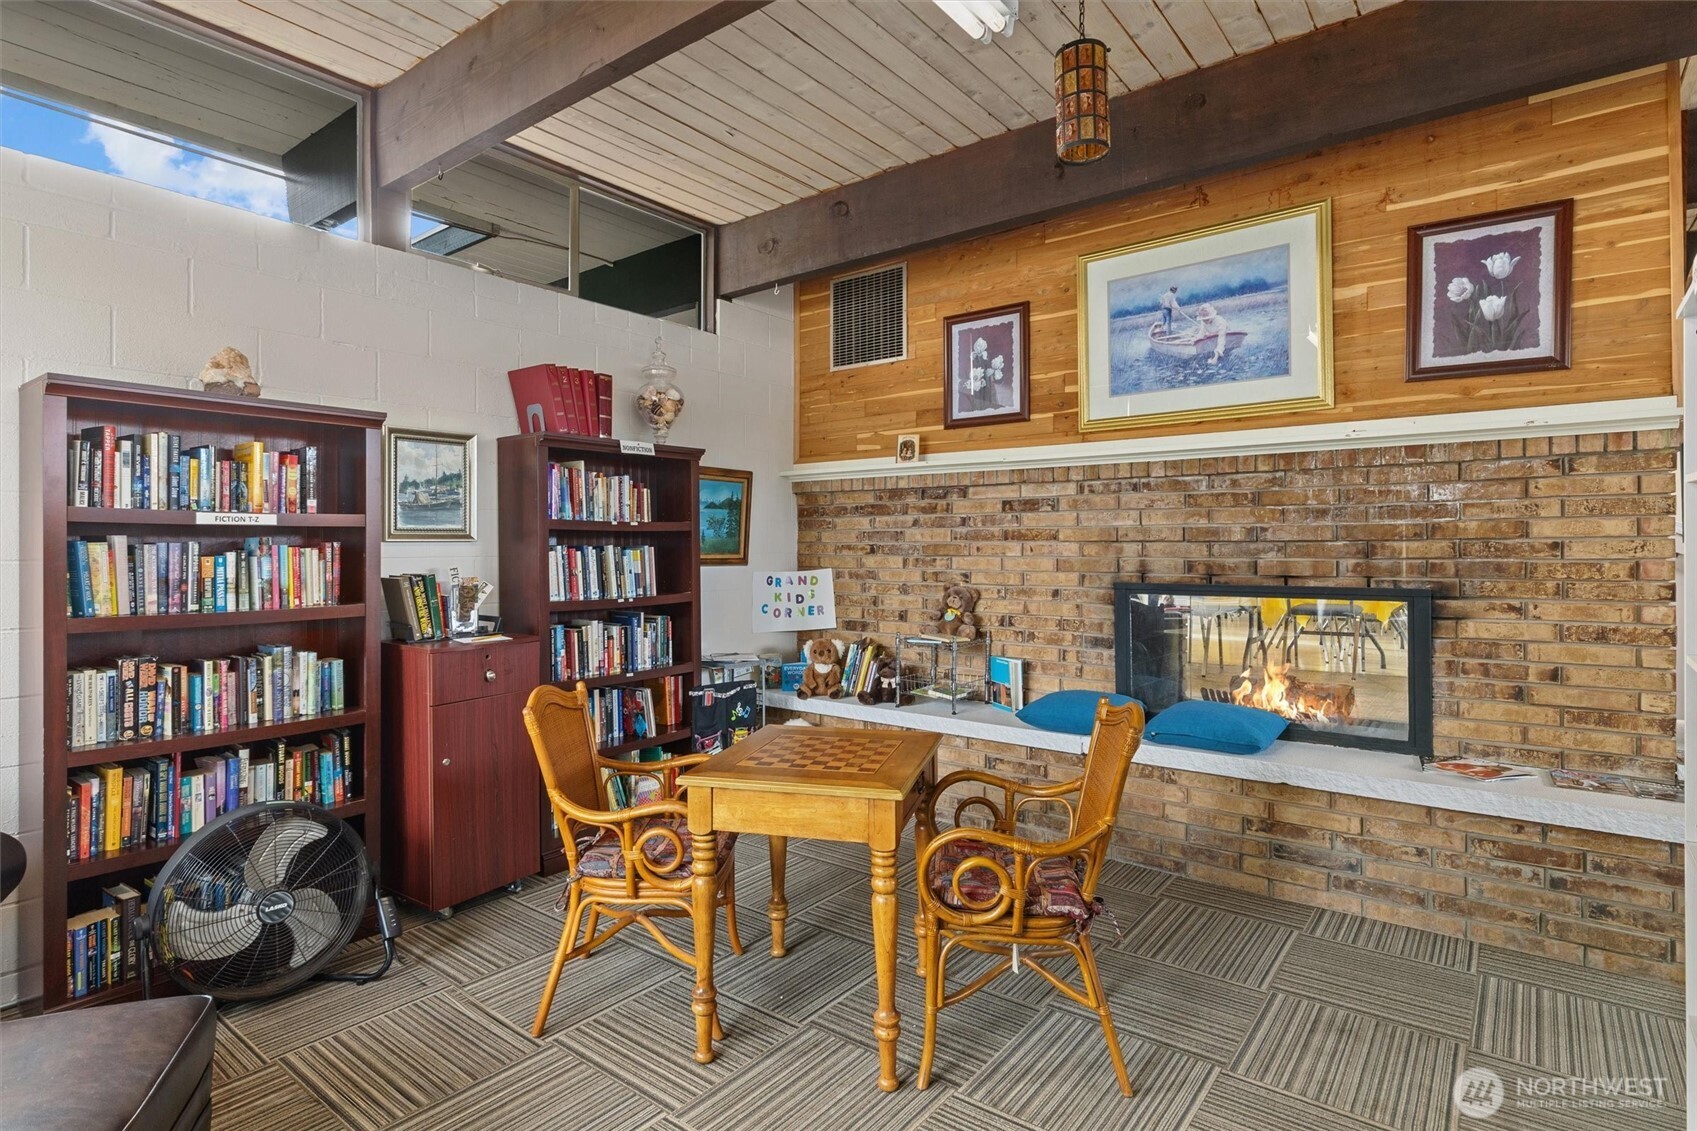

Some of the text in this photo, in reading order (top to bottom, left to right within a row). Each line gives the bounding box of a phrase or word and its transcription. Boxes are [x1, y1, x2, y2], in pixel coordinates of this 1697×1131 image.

[622, 445, 653, 453] NONFICTION
[450, 567, 460, 584] FIC
[766, 575, 819, 588] GRAND
[216, 583, 225, 598] PASS
[418, 581, 426, 592] 2000
[774, 589, 816, 604] KIDS
[761, 603, 825, 618] CORNER
[139, 662, 148, 689] WEBER
[148, 662, 156, 686] DAVID
[125, 688, 134, 702] ALL
[139, 690, 147, 723] HONOR
[147, 690, 156, 723] WAR OF
[123, 702, 134, 728] COSTS
[265, 902, 288, 912] LASKO
[128, 946, 136, 966] GLORY
